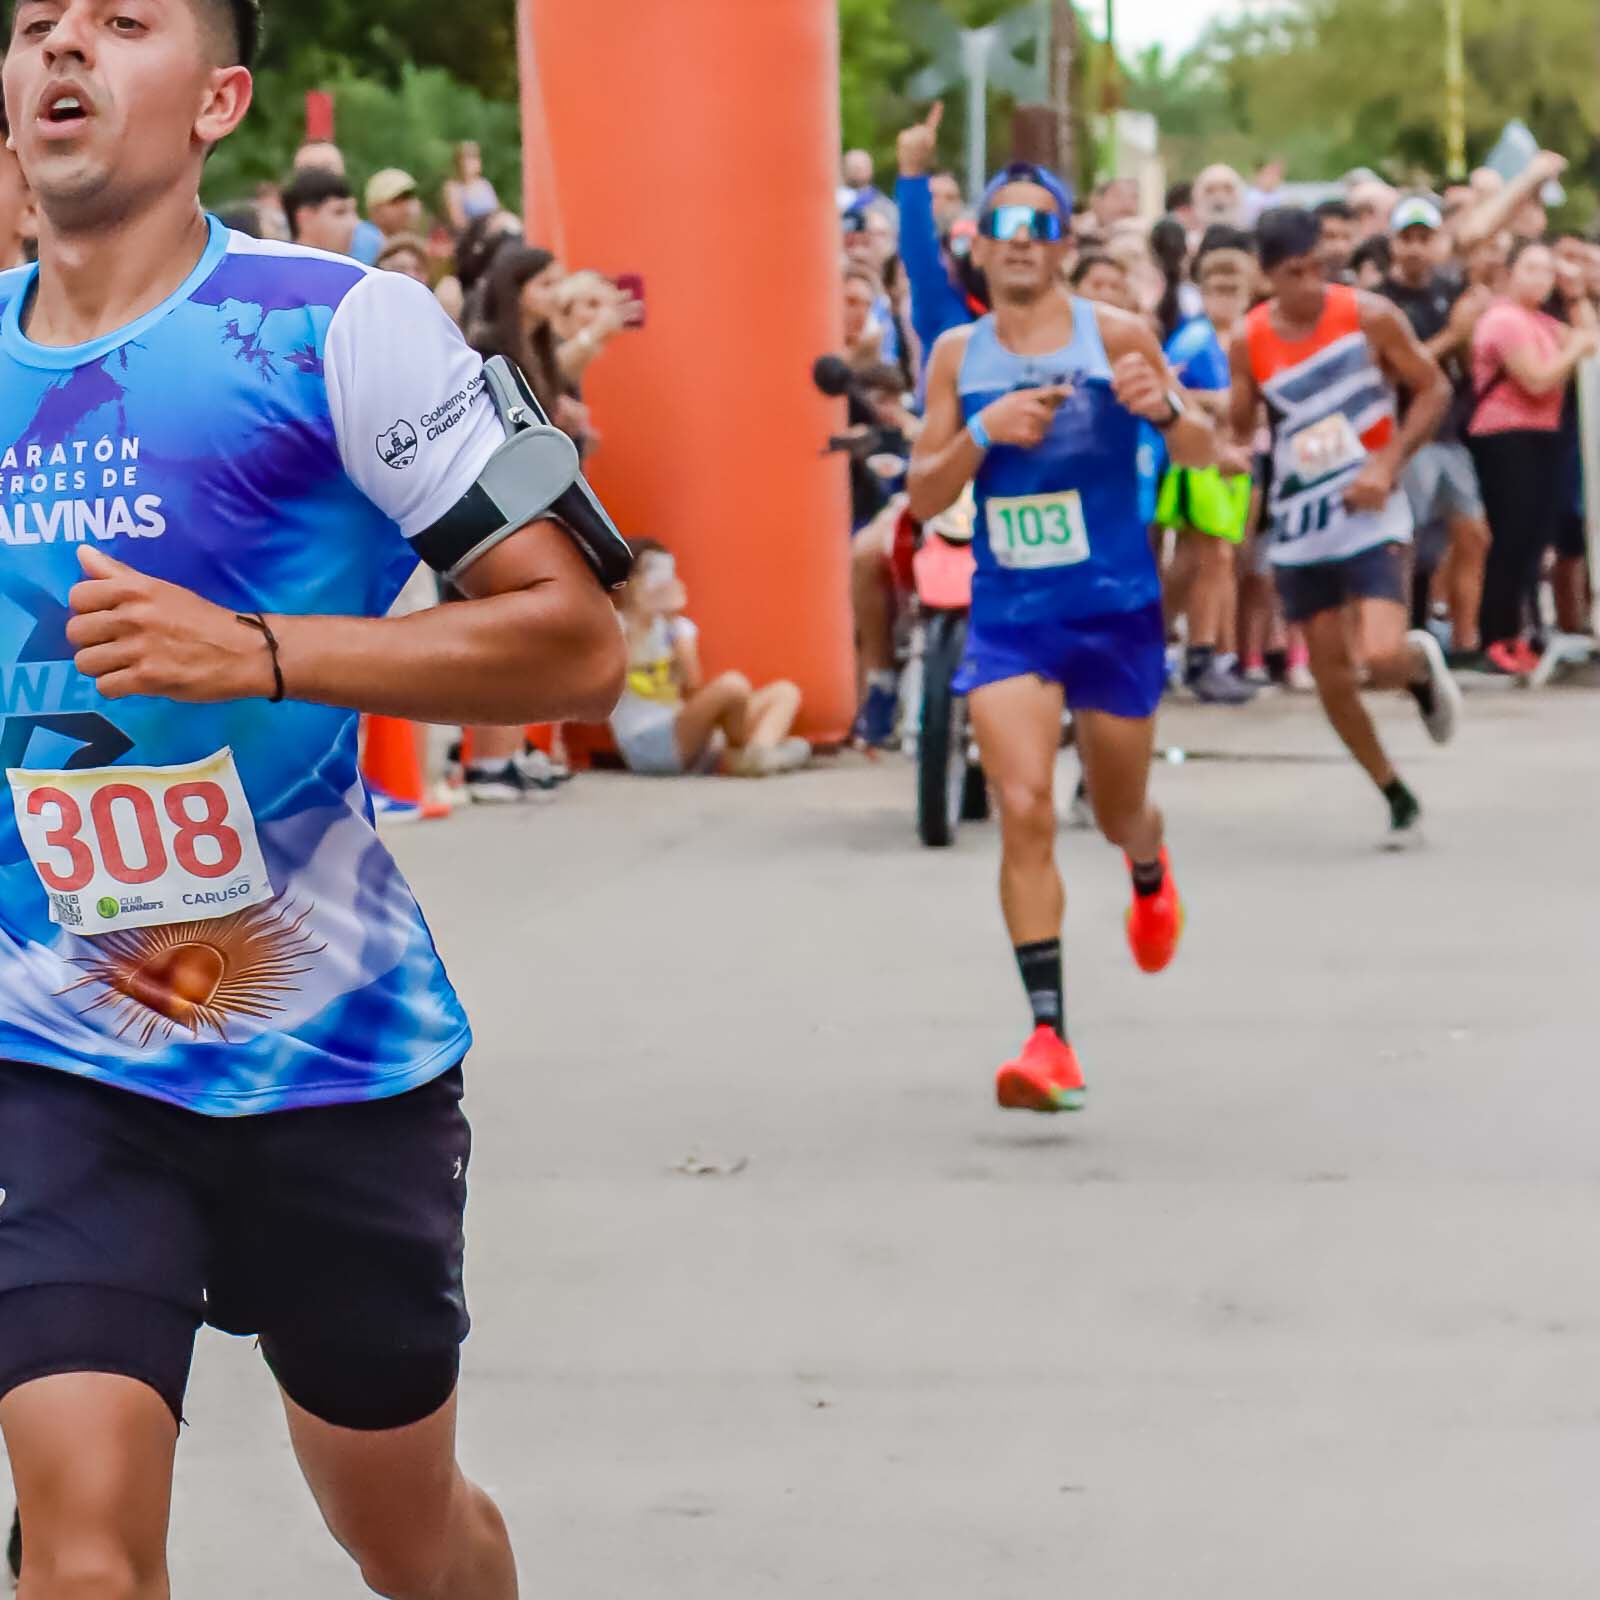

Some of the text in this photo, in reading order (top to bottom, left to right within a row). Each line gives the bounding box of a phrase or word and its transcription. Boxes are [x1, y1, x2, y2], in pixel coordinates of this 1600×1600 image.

[419, 390, 468, 427] Gobierno
[426, 406, 466, 441] Ciudad
[102, 466, 138, 488] DE
[998, 504, 1071, 549] 103
[27, 781, 243, 892] 308
[182, 883, 250, 905] CARUSO
